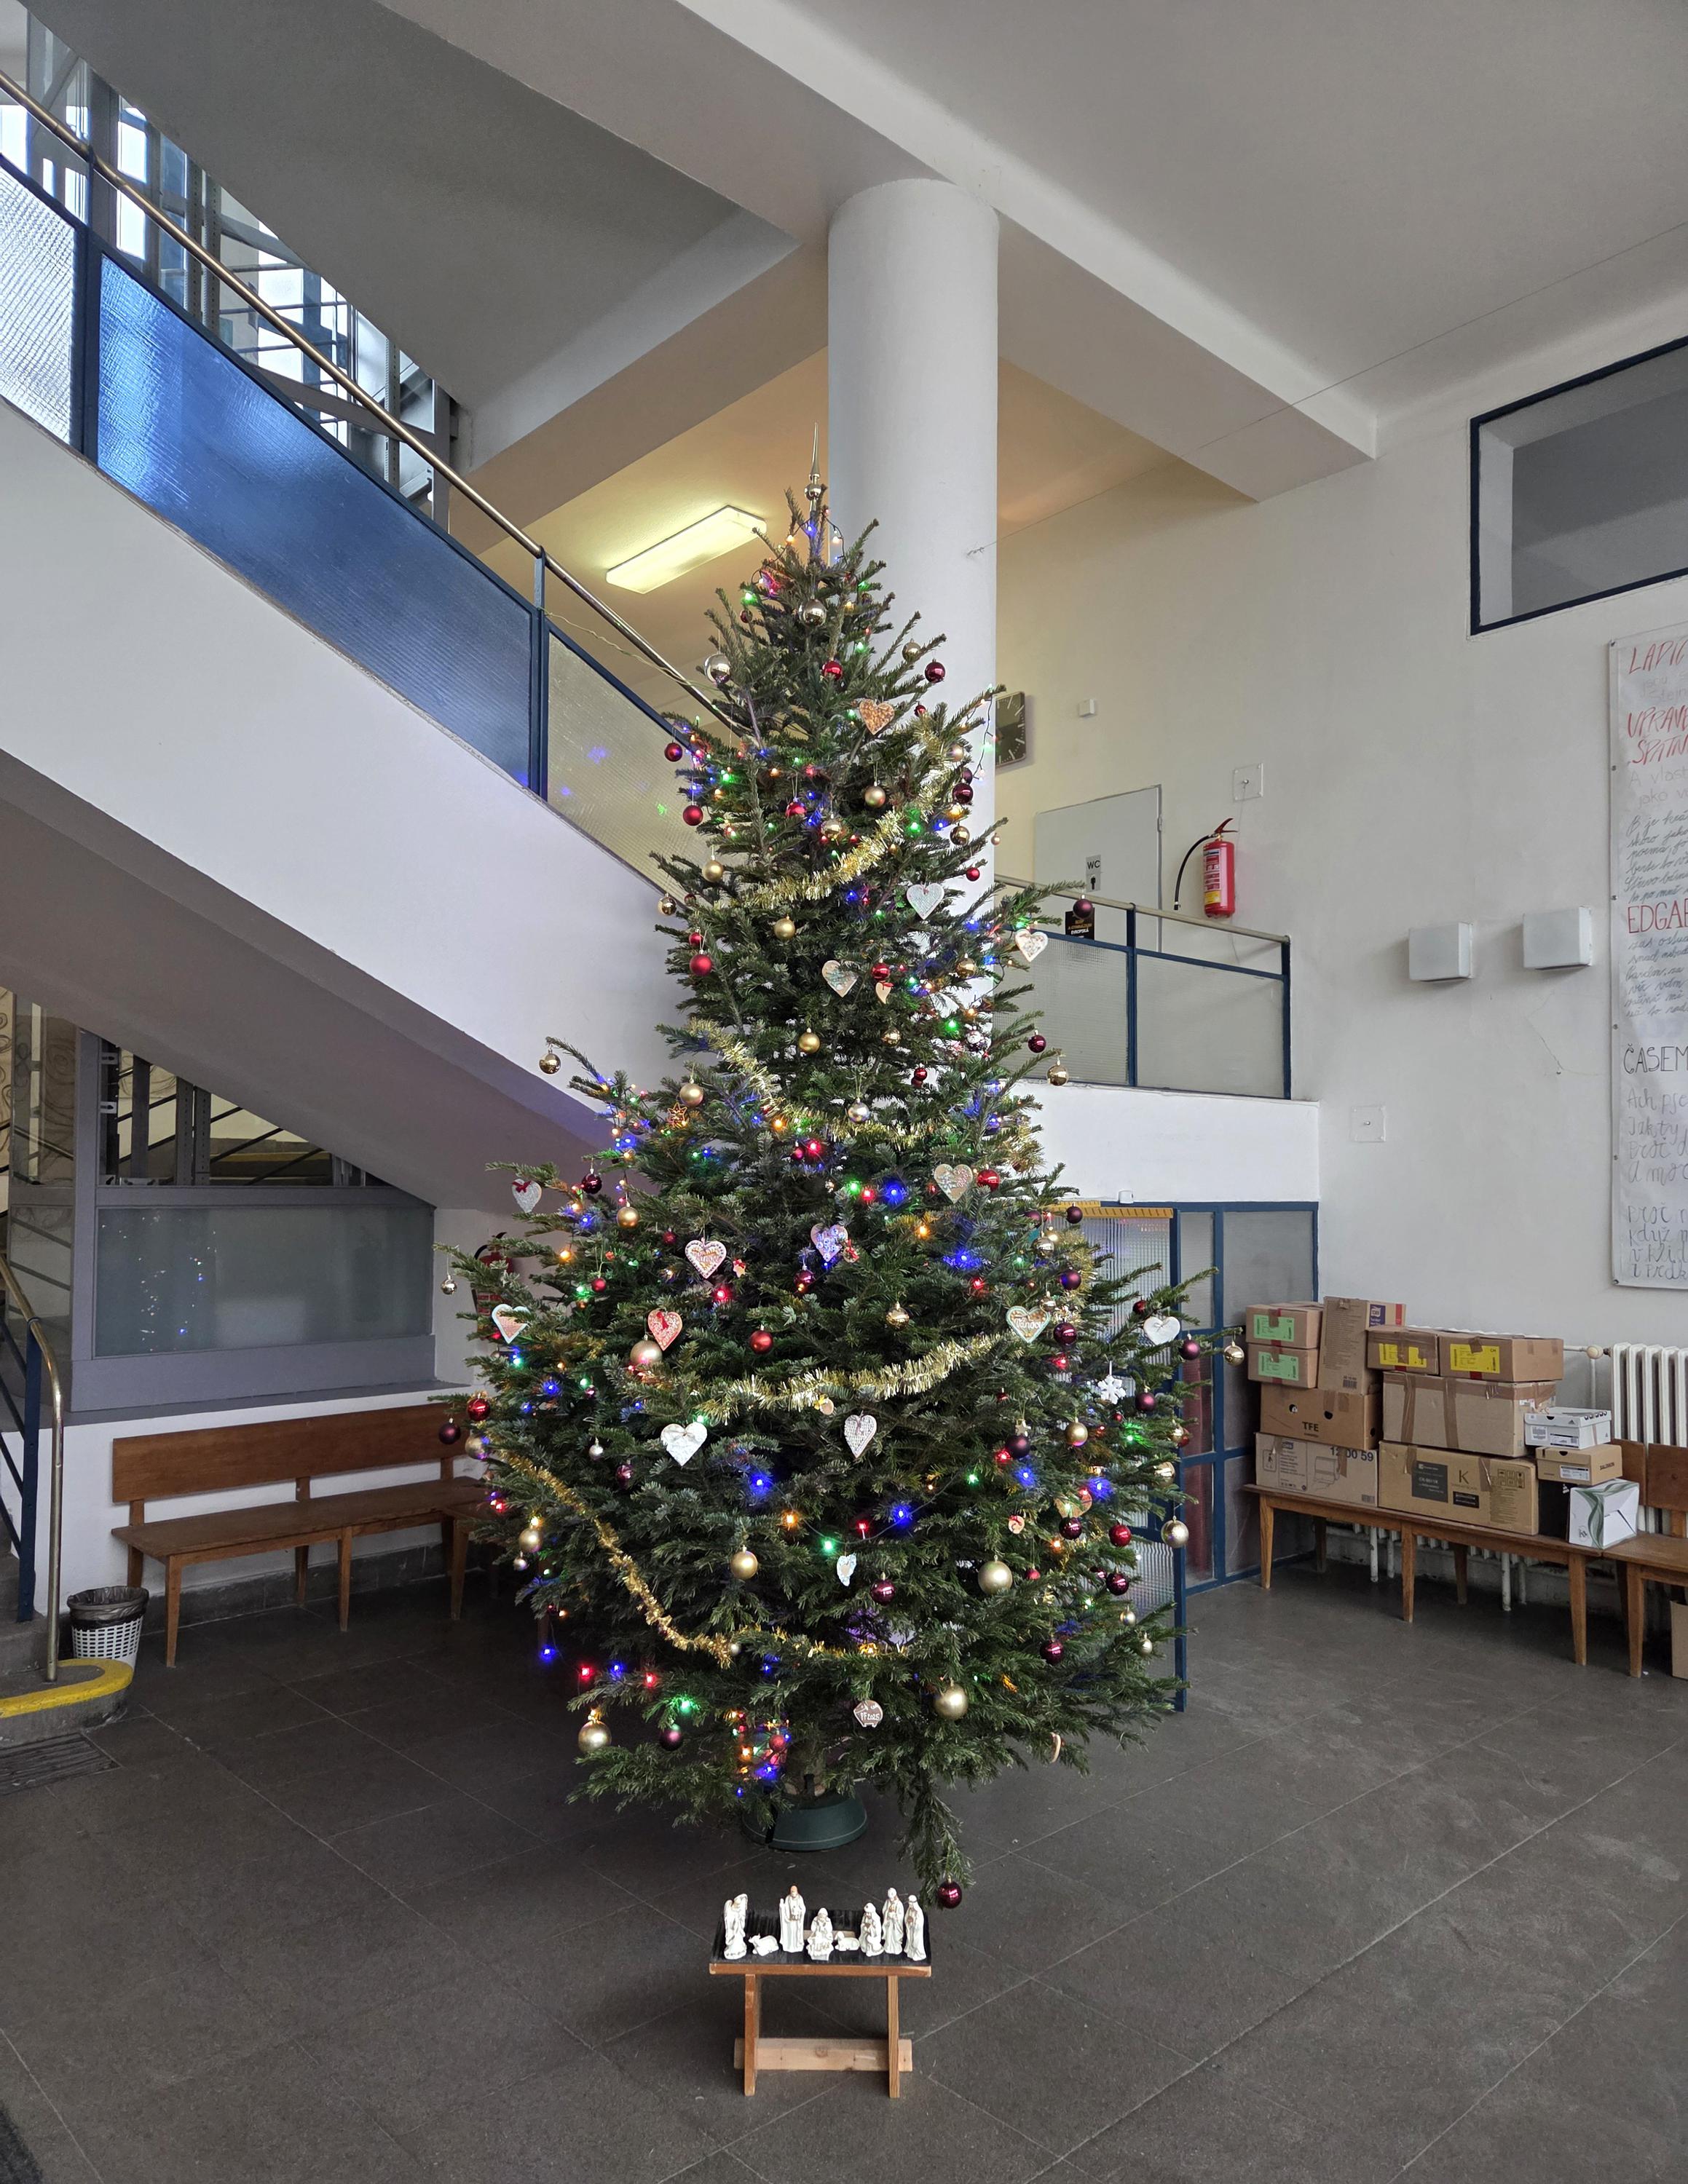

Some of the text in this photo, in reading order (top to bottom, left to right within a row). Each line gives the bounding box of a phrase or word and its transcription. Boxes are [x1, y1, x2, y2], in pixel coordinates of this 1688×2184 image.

[1086, 860, 1100, 870] WC
[1302, 1421, 1320, 1432] TFE
[1360, 1450, 1373, 1462] 59
[1459, 1469, 1470, 1485] K
